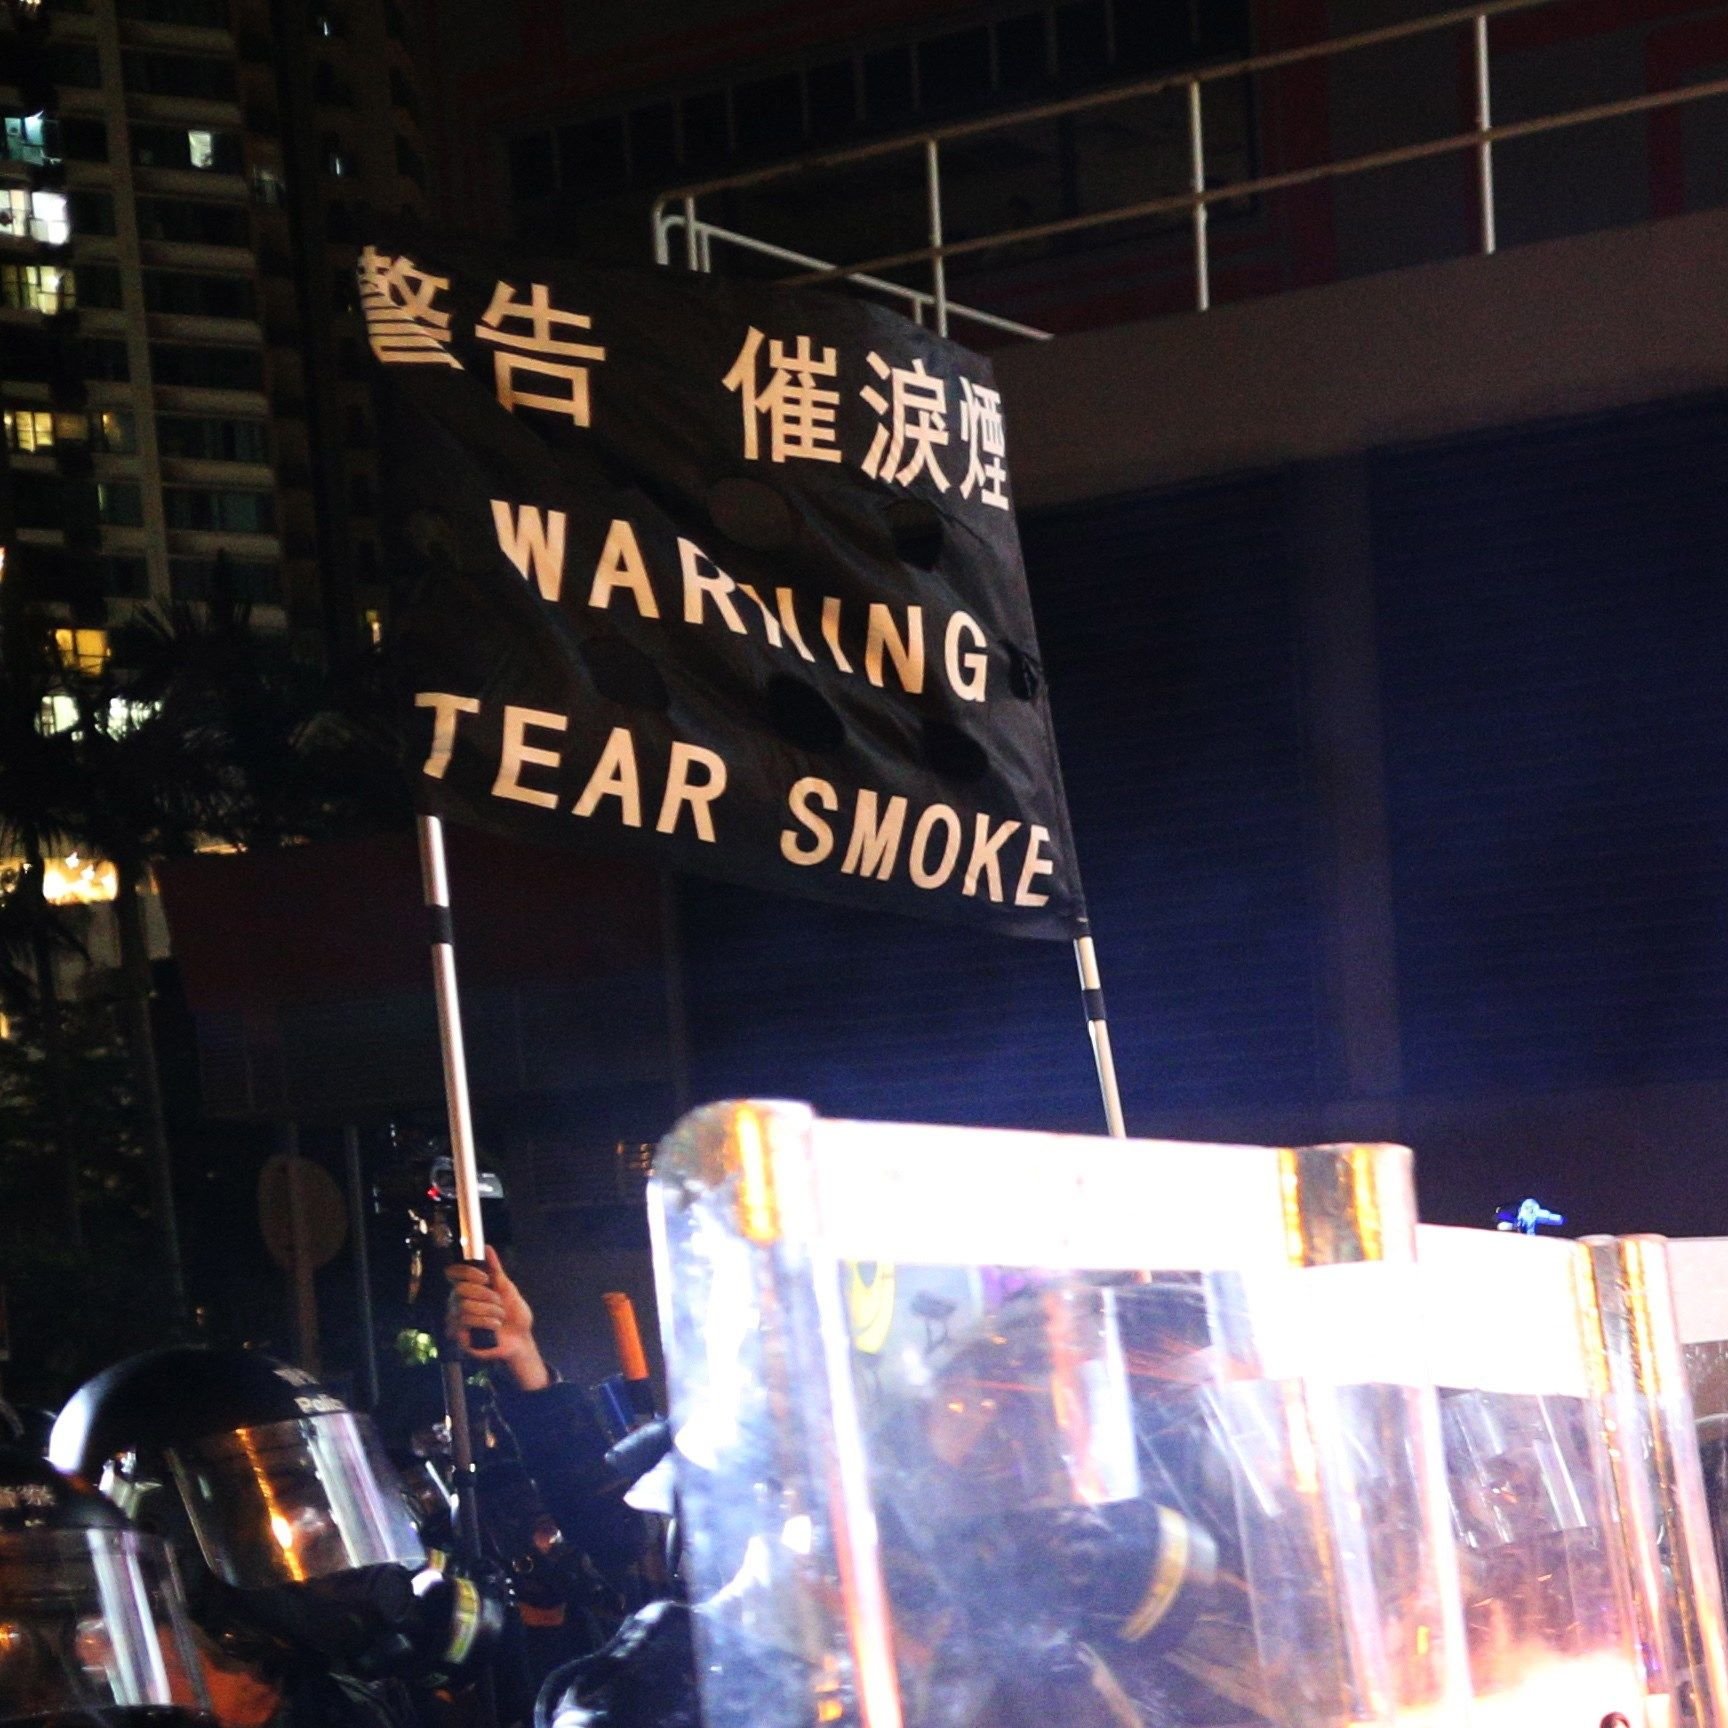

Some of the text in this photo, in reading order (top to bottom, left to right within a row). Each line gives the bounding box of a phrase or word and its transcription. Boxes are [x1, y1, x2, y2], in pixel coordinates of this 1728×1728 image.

[356, 244, 1009, 512] 警告 催淚煙
[414, 691, 1056, 908] TEAR SMOKE
